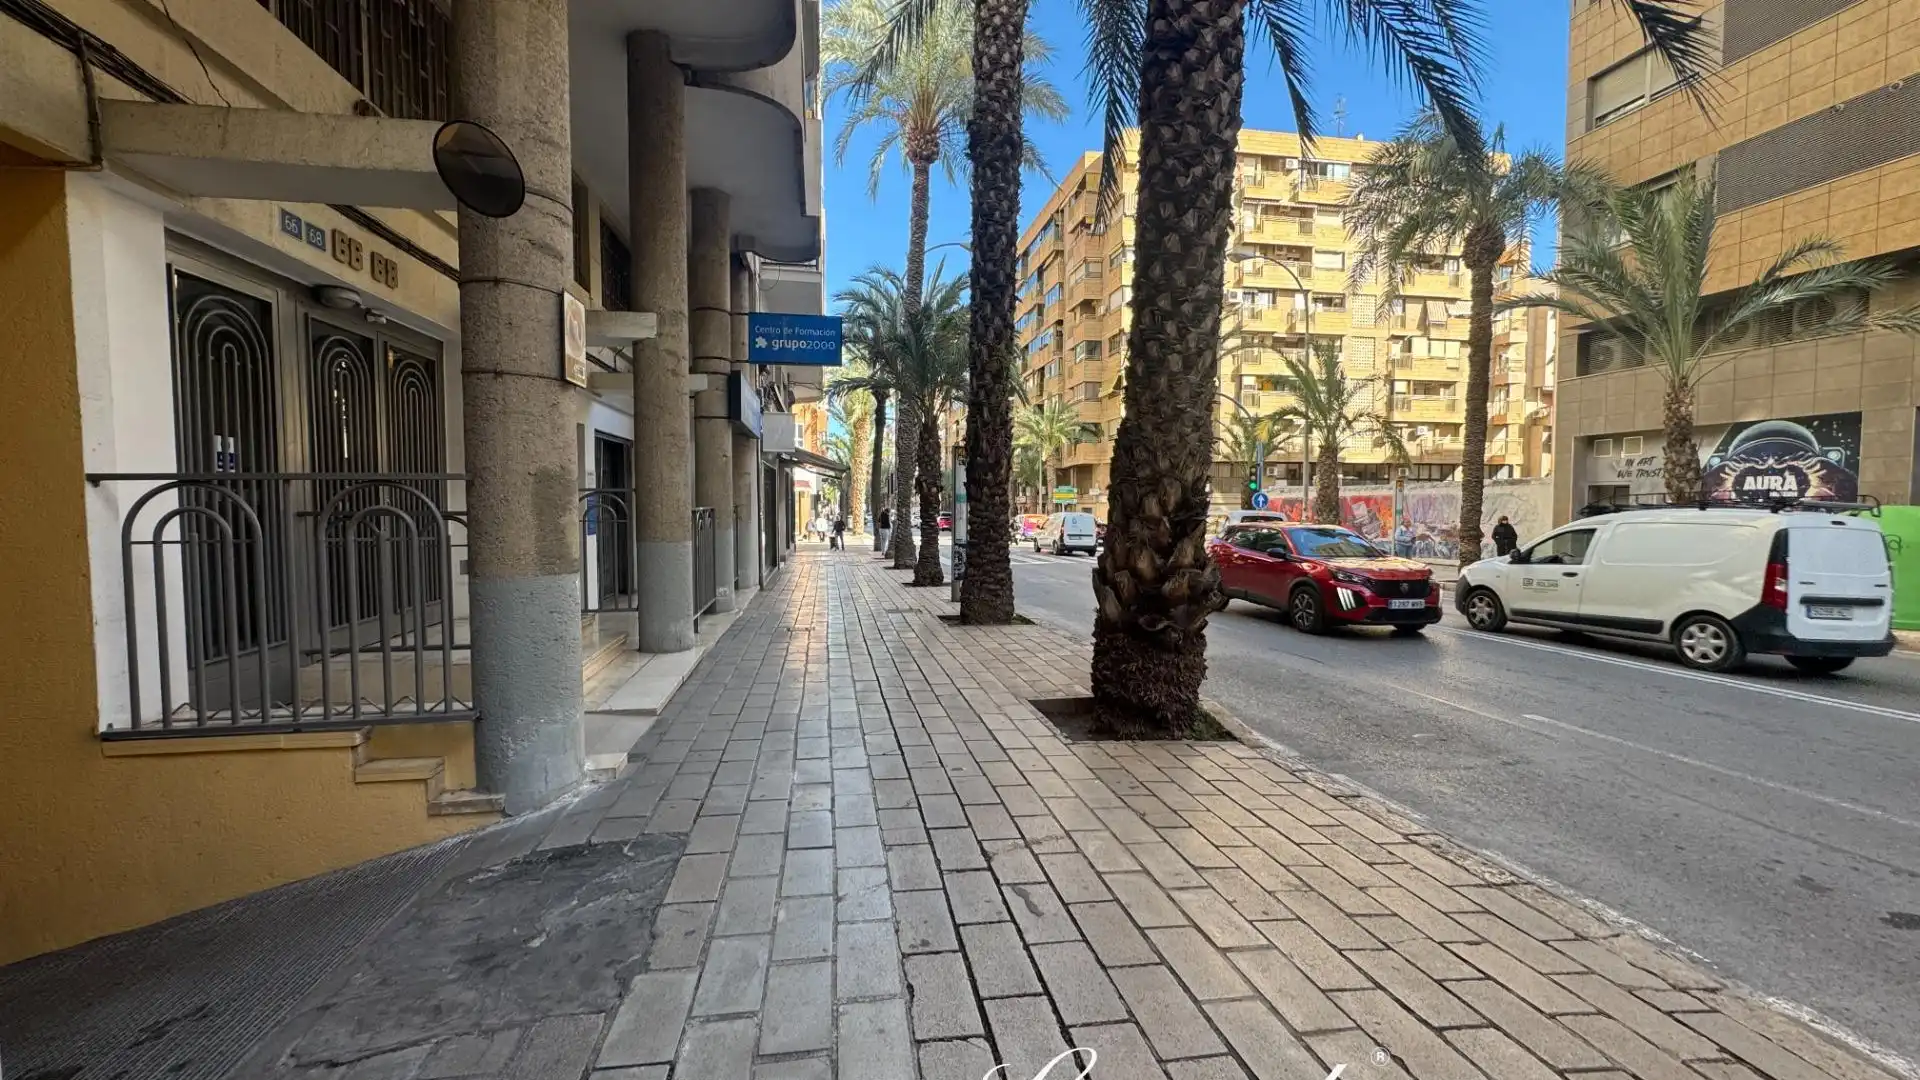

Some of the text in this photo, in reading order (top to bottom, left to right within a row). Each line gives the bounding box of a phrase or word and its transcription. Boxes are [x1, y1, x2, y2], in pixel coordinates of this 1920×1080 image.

[285, 215, 299, 234] 66
[309, 228, 323, 246] 68
[331, 228, 398, 290] 66 68
[754, 325, 836, 337] Centro de Formación
[771, 339, 836, 351] grupo2000
[1625, 456, 1656, 467] IN ART
[1617, 467, 1664, 479] WE TRUST
[1742, 472, 1798, 491] AURA
